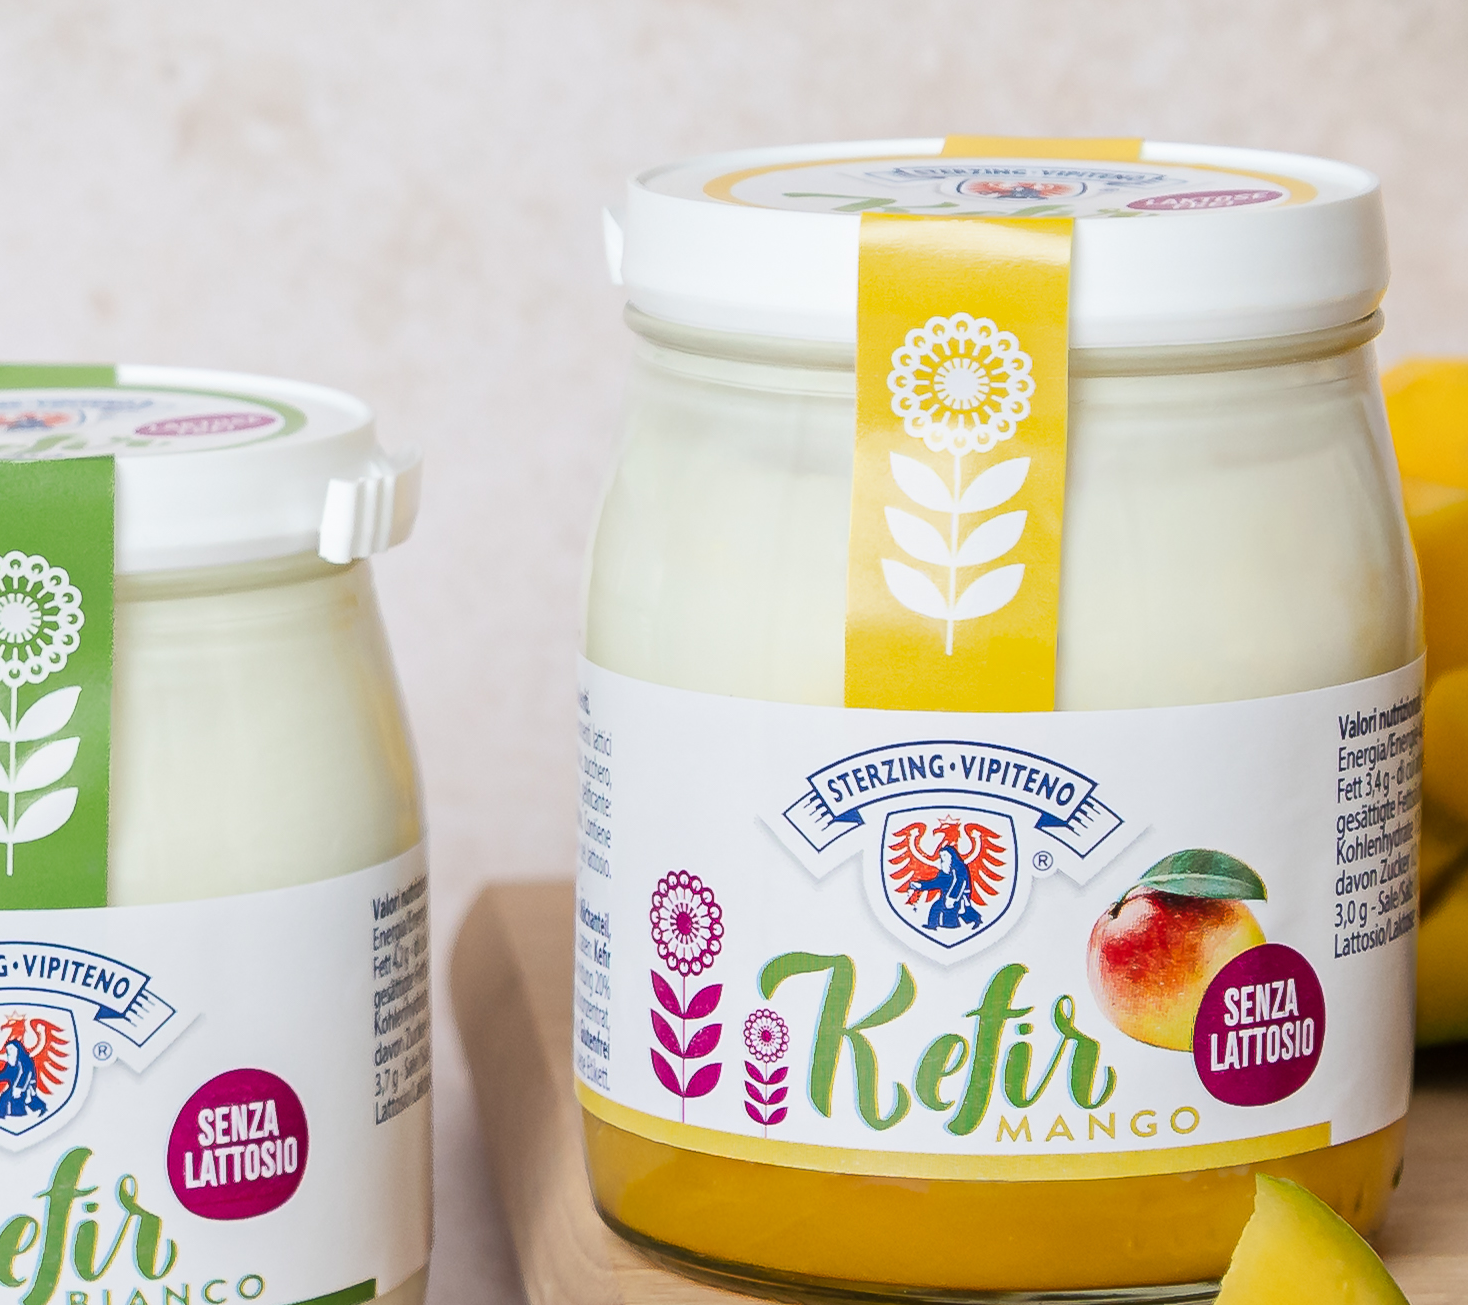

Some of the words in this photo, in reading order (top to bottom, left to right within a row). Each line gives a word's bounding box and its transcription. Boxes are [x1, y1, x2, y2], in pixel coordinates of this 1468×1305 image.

[1338, 707, 1377, 741] Valori
[827, 754, 945, 803] STERZING
[960, 754, 1076, 807] VIPITENO
[1337, 776, 1363, 804] Fett
[1365, 769, 1381, 798] 3,4
[1336, 799, 1396, 841] gesättigte
[1335, 869, 1378, 897] davon
[1334, 900, 1357, 930] 3,0
[1359, 902, 1368, 928] g
[22, 953, 130, 999] VIPITENO
[1223, 978, 1300, 1028] SENZA
[757, 950, 1118, 1137] Kefir
[1209, 1017, 1316, 1073] LATTOSIO
[197, 1098, 280, 1148] SENZA
[994, 1106, 1201, 1143] MANGO
[183, 1138, 299, 1190] LATTOSIO
